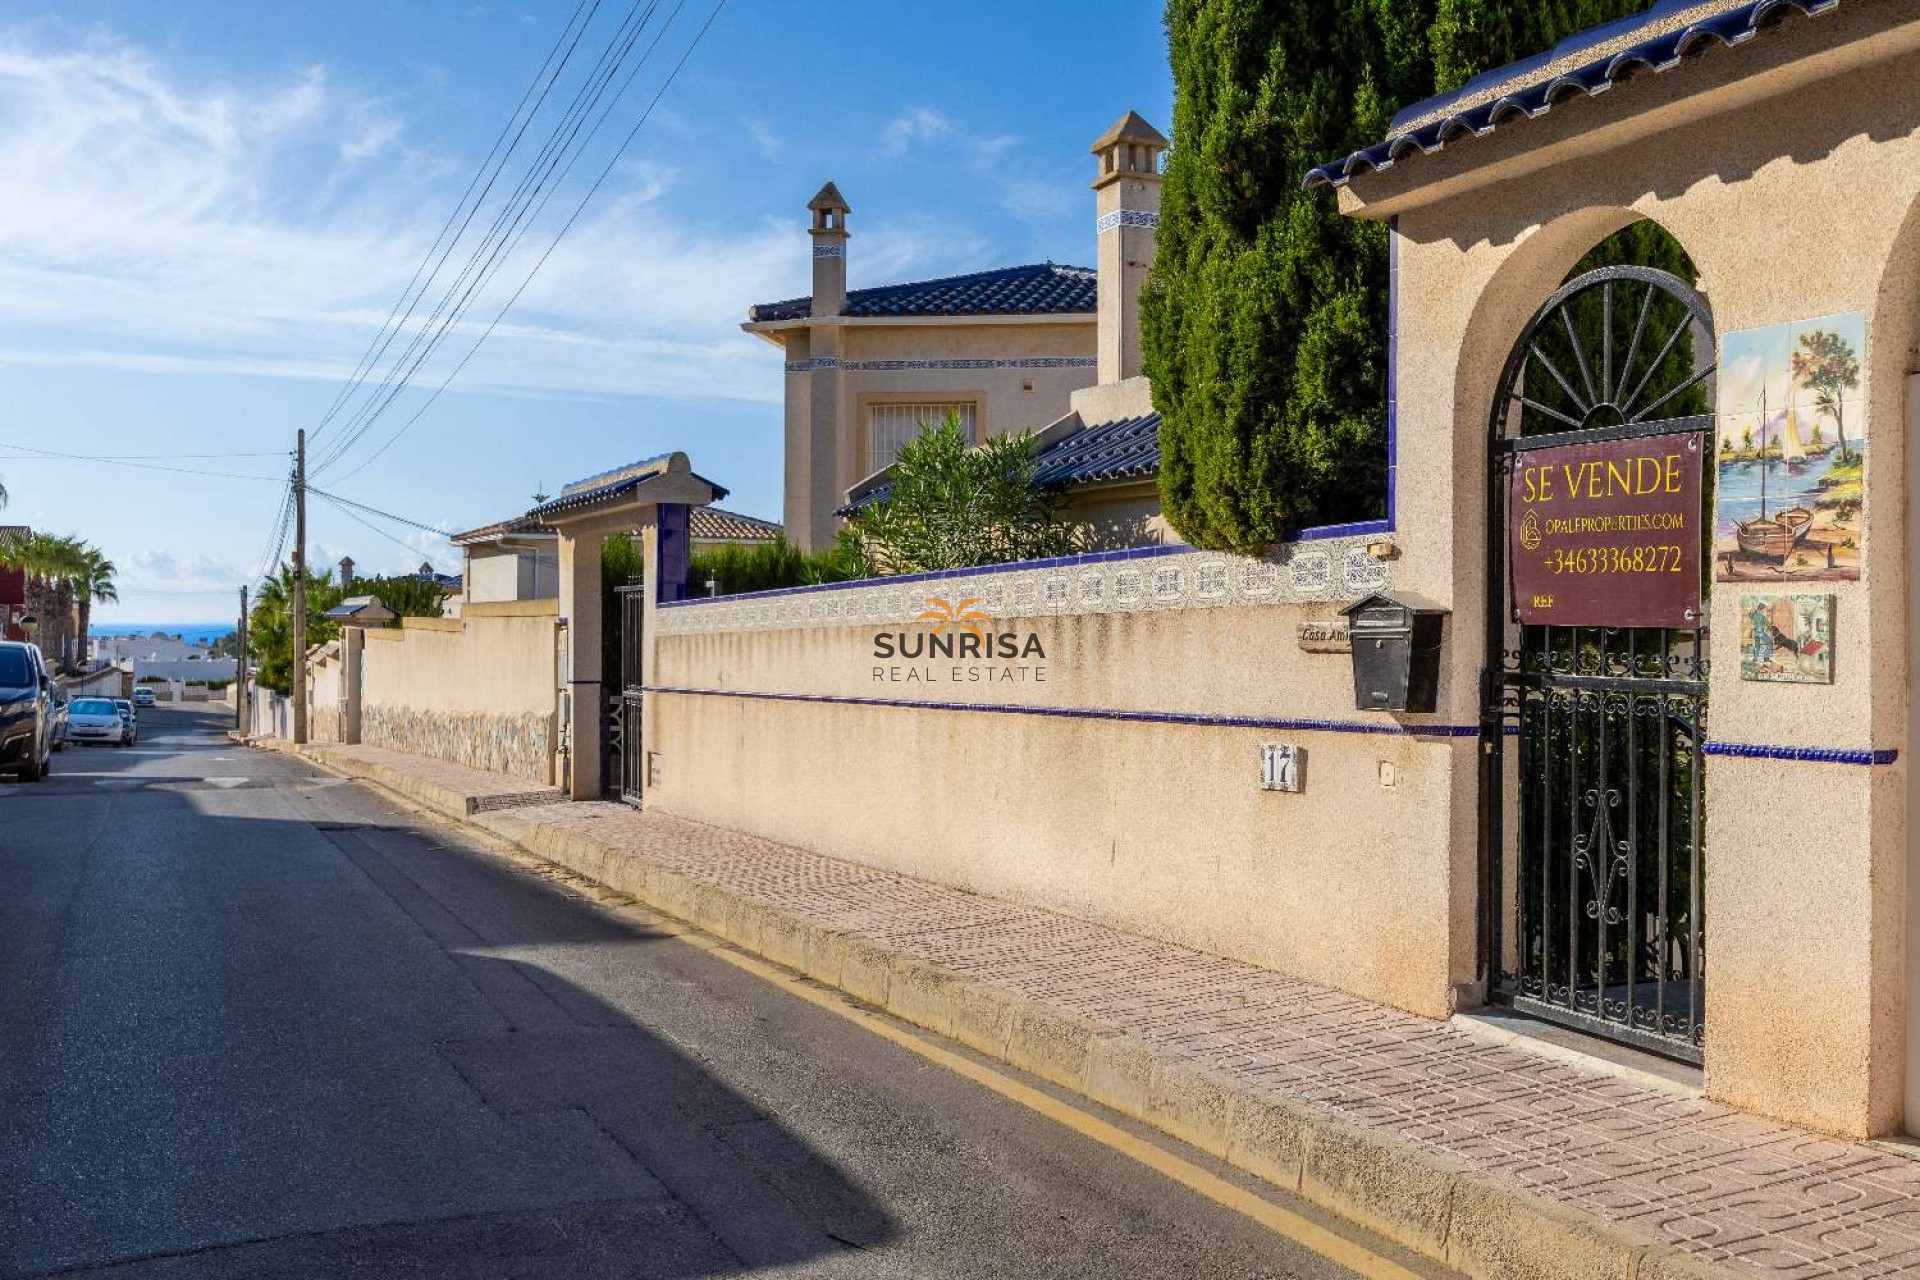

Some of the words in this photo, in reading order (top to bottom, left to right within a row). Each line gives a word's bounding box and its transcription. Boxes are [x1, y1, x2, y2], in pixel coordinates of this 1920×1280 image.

[1523, 466, 1554, 503] SE
[1563, 454, 1682, 499] VENDE
[1544, 545, 1683, 575] +34633368272
[1302, 628, 1327, 641] Casa
[1329, 627, 1350, 641] Ami
[1268, 751, 1290, 782] 17
